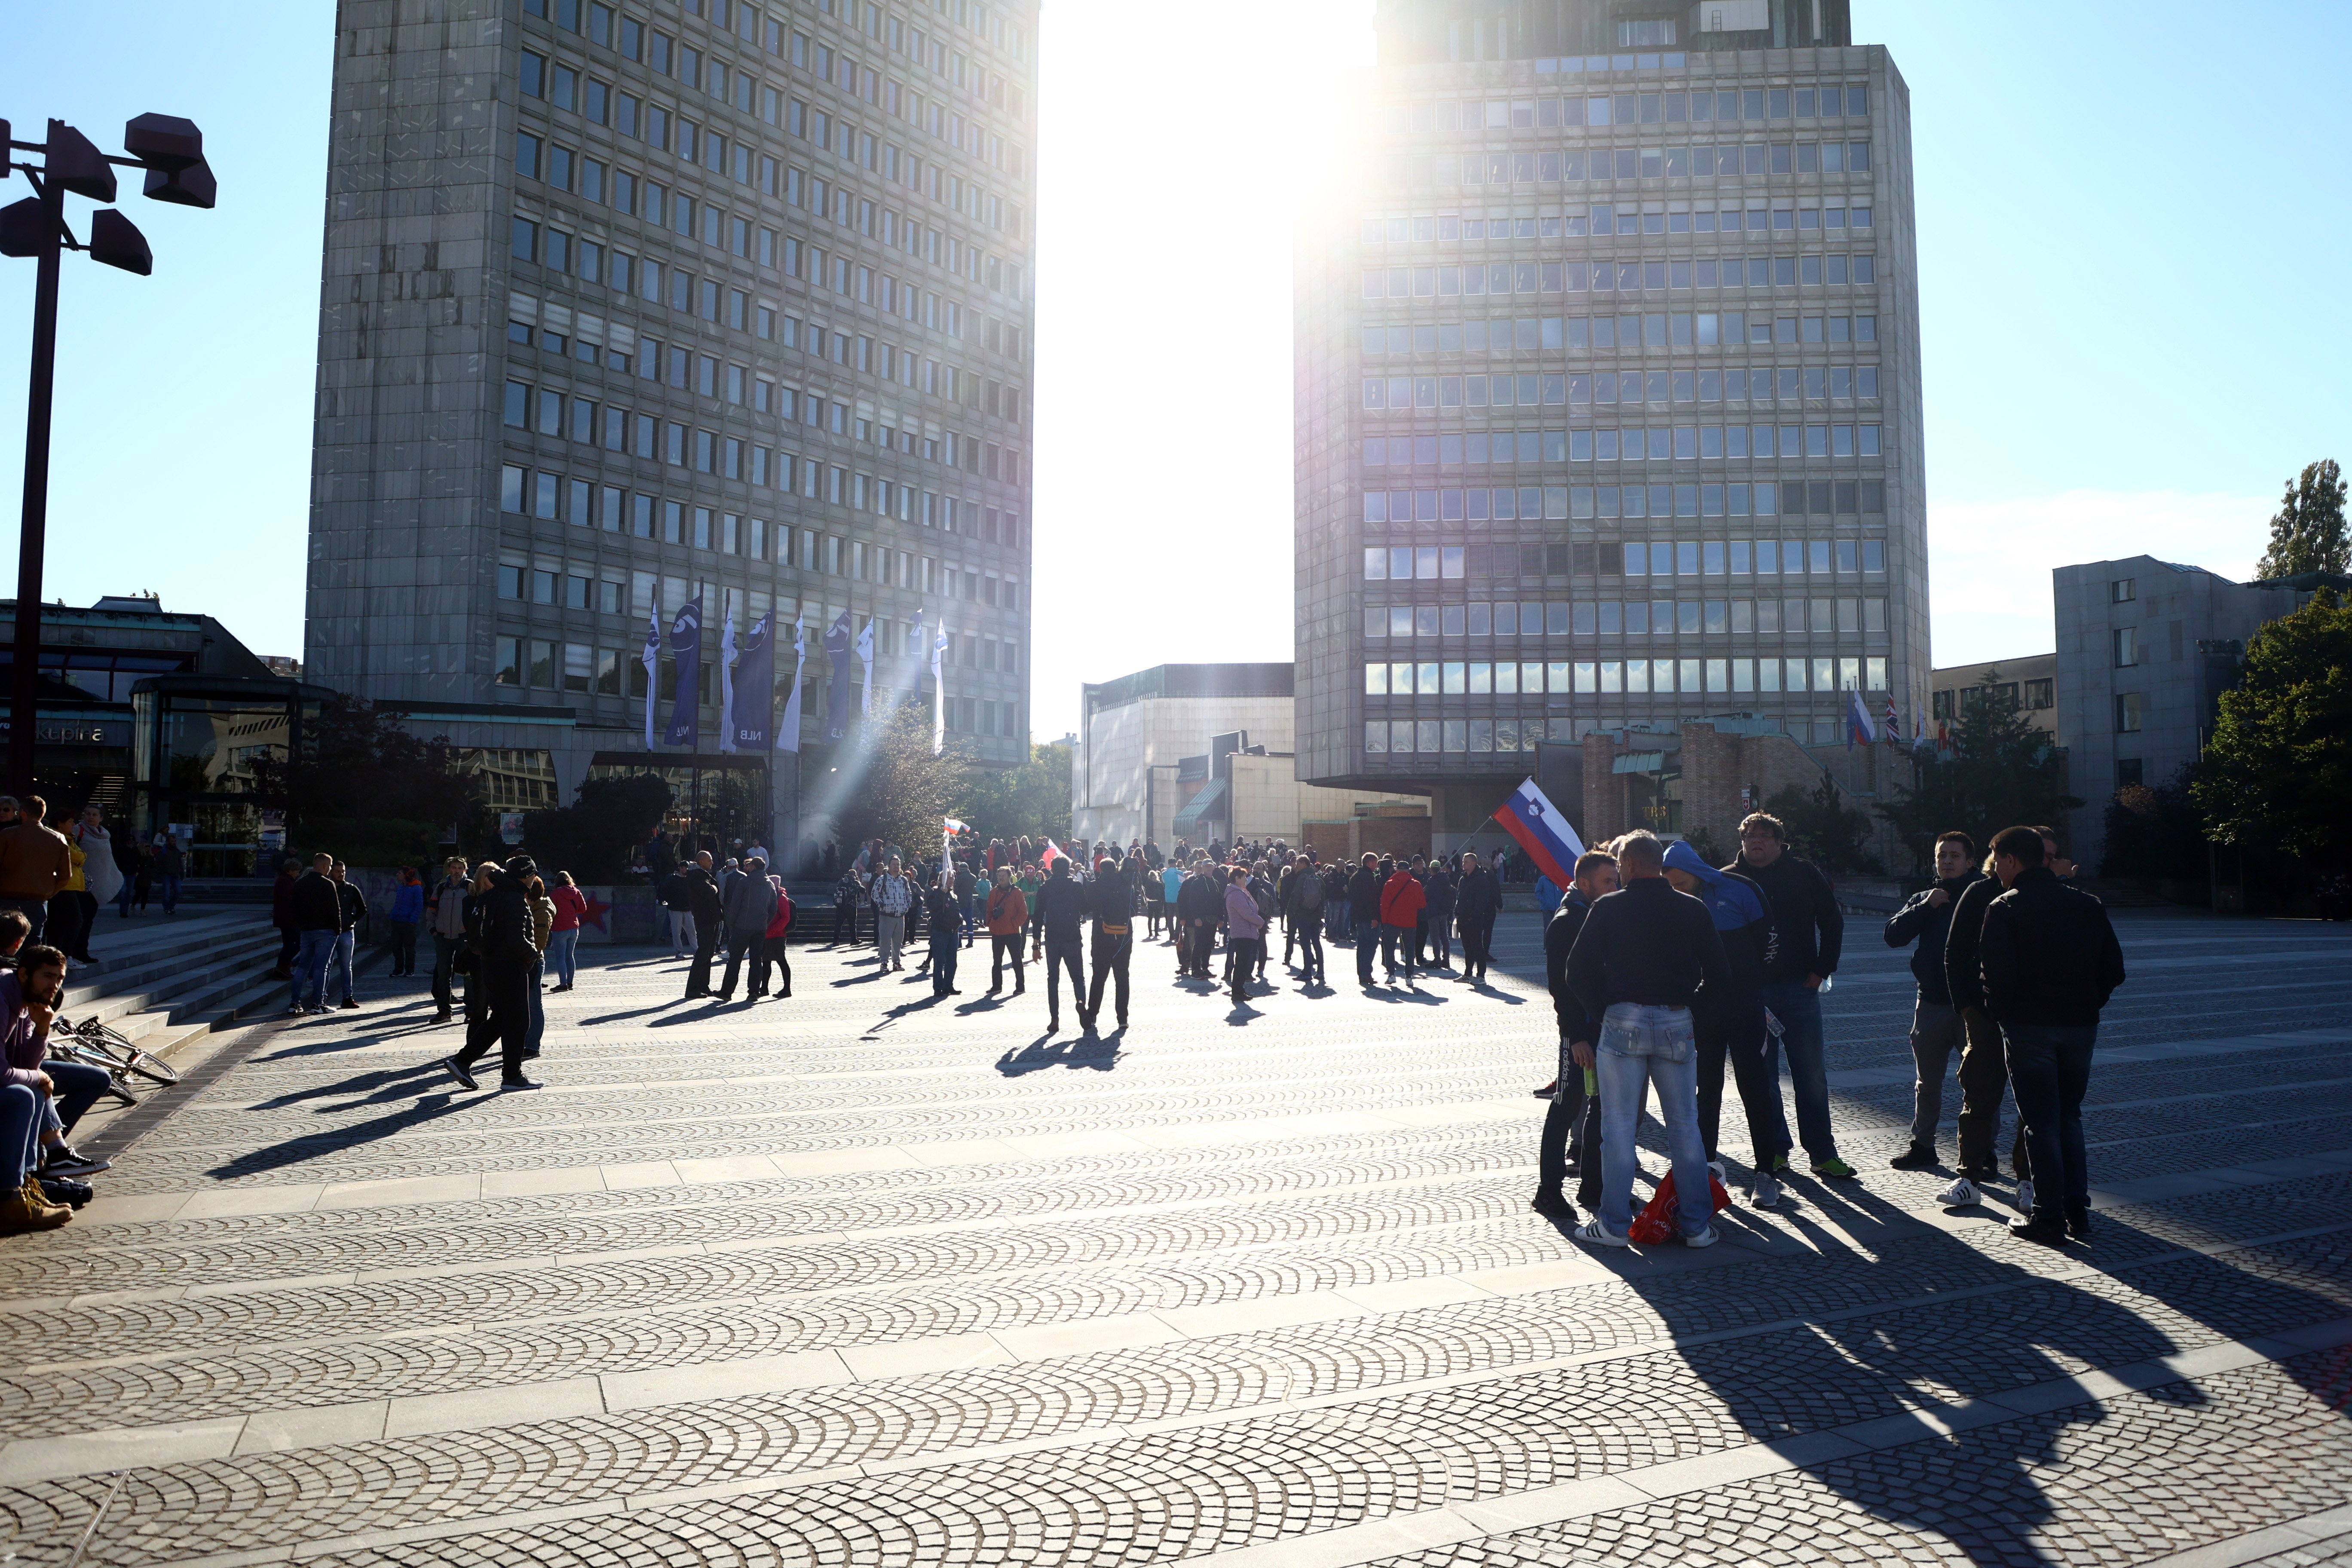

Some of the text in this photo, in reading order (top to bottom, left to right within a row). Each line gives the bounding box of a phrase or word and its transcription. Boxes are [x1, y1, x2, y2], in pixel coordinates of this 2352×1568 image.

[35, 719, 104, 744] kupina
[1642, 805, 1666, 817] TR3
[1561, 1050, 1570, 1081] adidas
